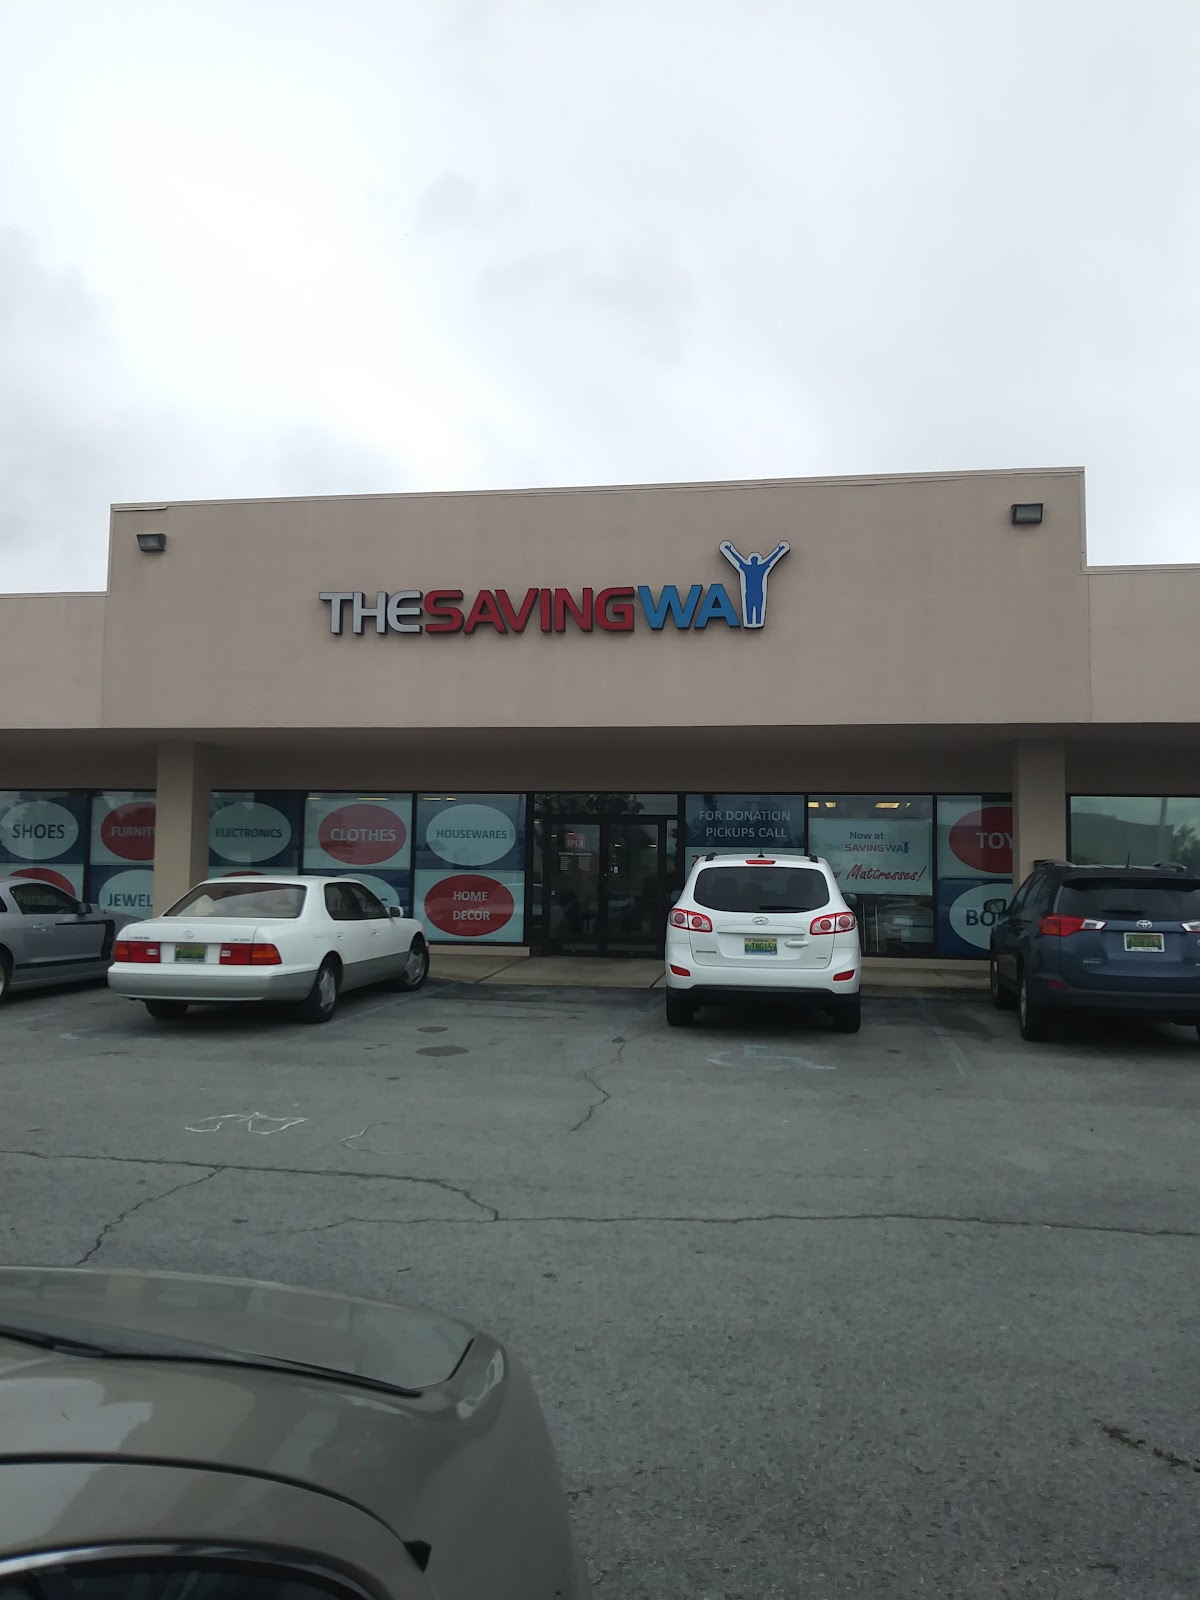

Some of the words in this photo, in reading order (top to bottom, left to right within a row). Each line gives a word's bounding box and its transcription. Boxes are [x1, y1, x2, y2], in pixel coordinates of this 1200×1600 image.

[700, 810, 722, 821] FOR
[725, 810, 791, 821] DONATION
[12, 824, 65, 839] SHOES
[215, 828, 283, 838] ELECTRONICS
[330, 828, 397, 842] CLOTHES
[436, 829, 507, 840] HOUSEWARES
[706, 827, 755, 838] PICKUPS
[758, 827, 787, 838] CALL
[849, 831, 872, 840] Now
[874, 831, 885, 840] at
[846, 863, 927, 882] Mattresses!
[107, 893, 153, 908] JEWEL
[453, 891, 488, 901] HOME
[453, 910, 490, 921] DECOR
[965, 909, 999, 927] BO
